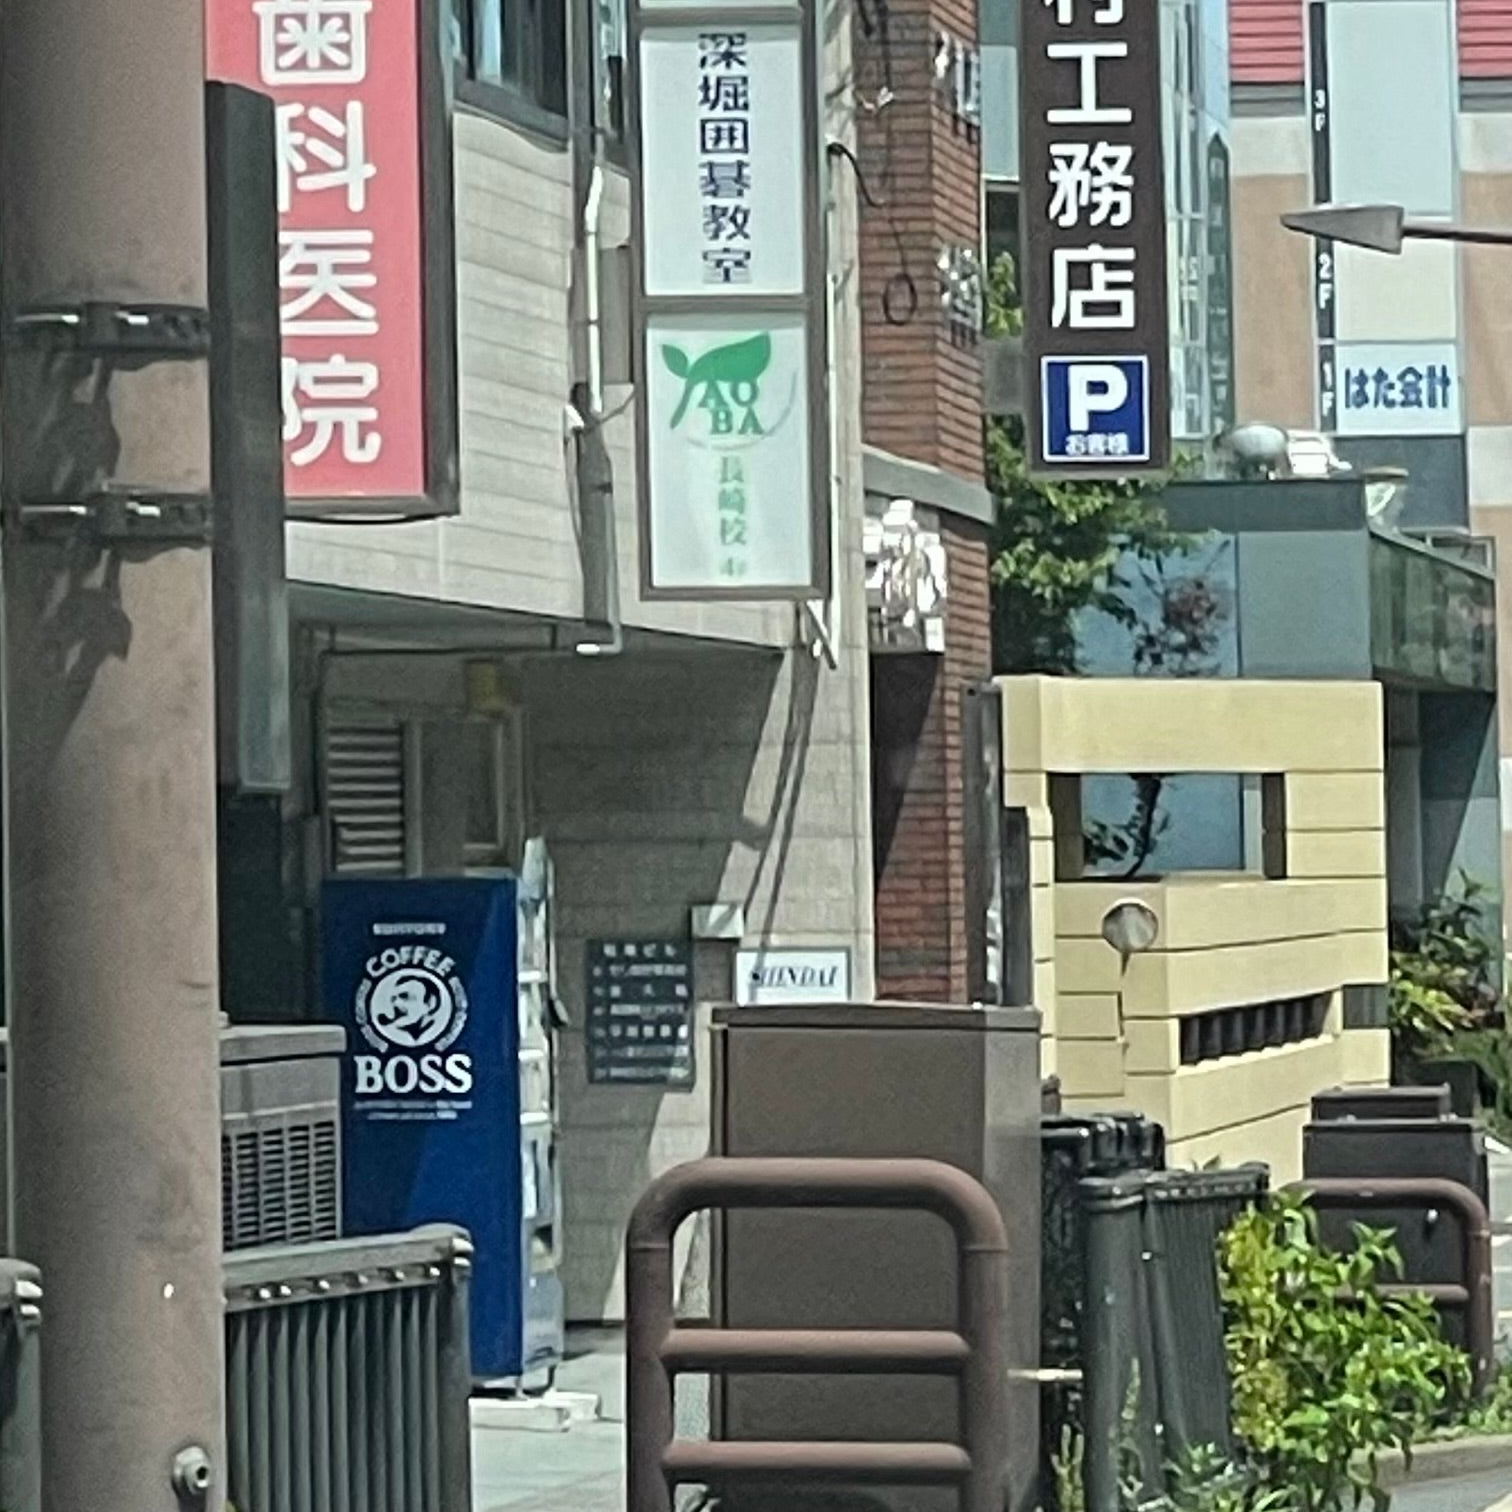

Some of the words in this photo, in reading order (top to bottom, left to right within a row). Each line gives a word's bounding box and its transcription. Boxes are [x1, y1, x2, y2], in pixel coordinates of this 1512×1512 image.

[698, 33, 753, 284] 深堀囲碁教室
[1068, 364, 1128, 431] P
[1345, 365, 1452, 410] はた会計
[365, 945, 457, 979] COFFEE
[353, 1053, 473, 1094] BOSS
